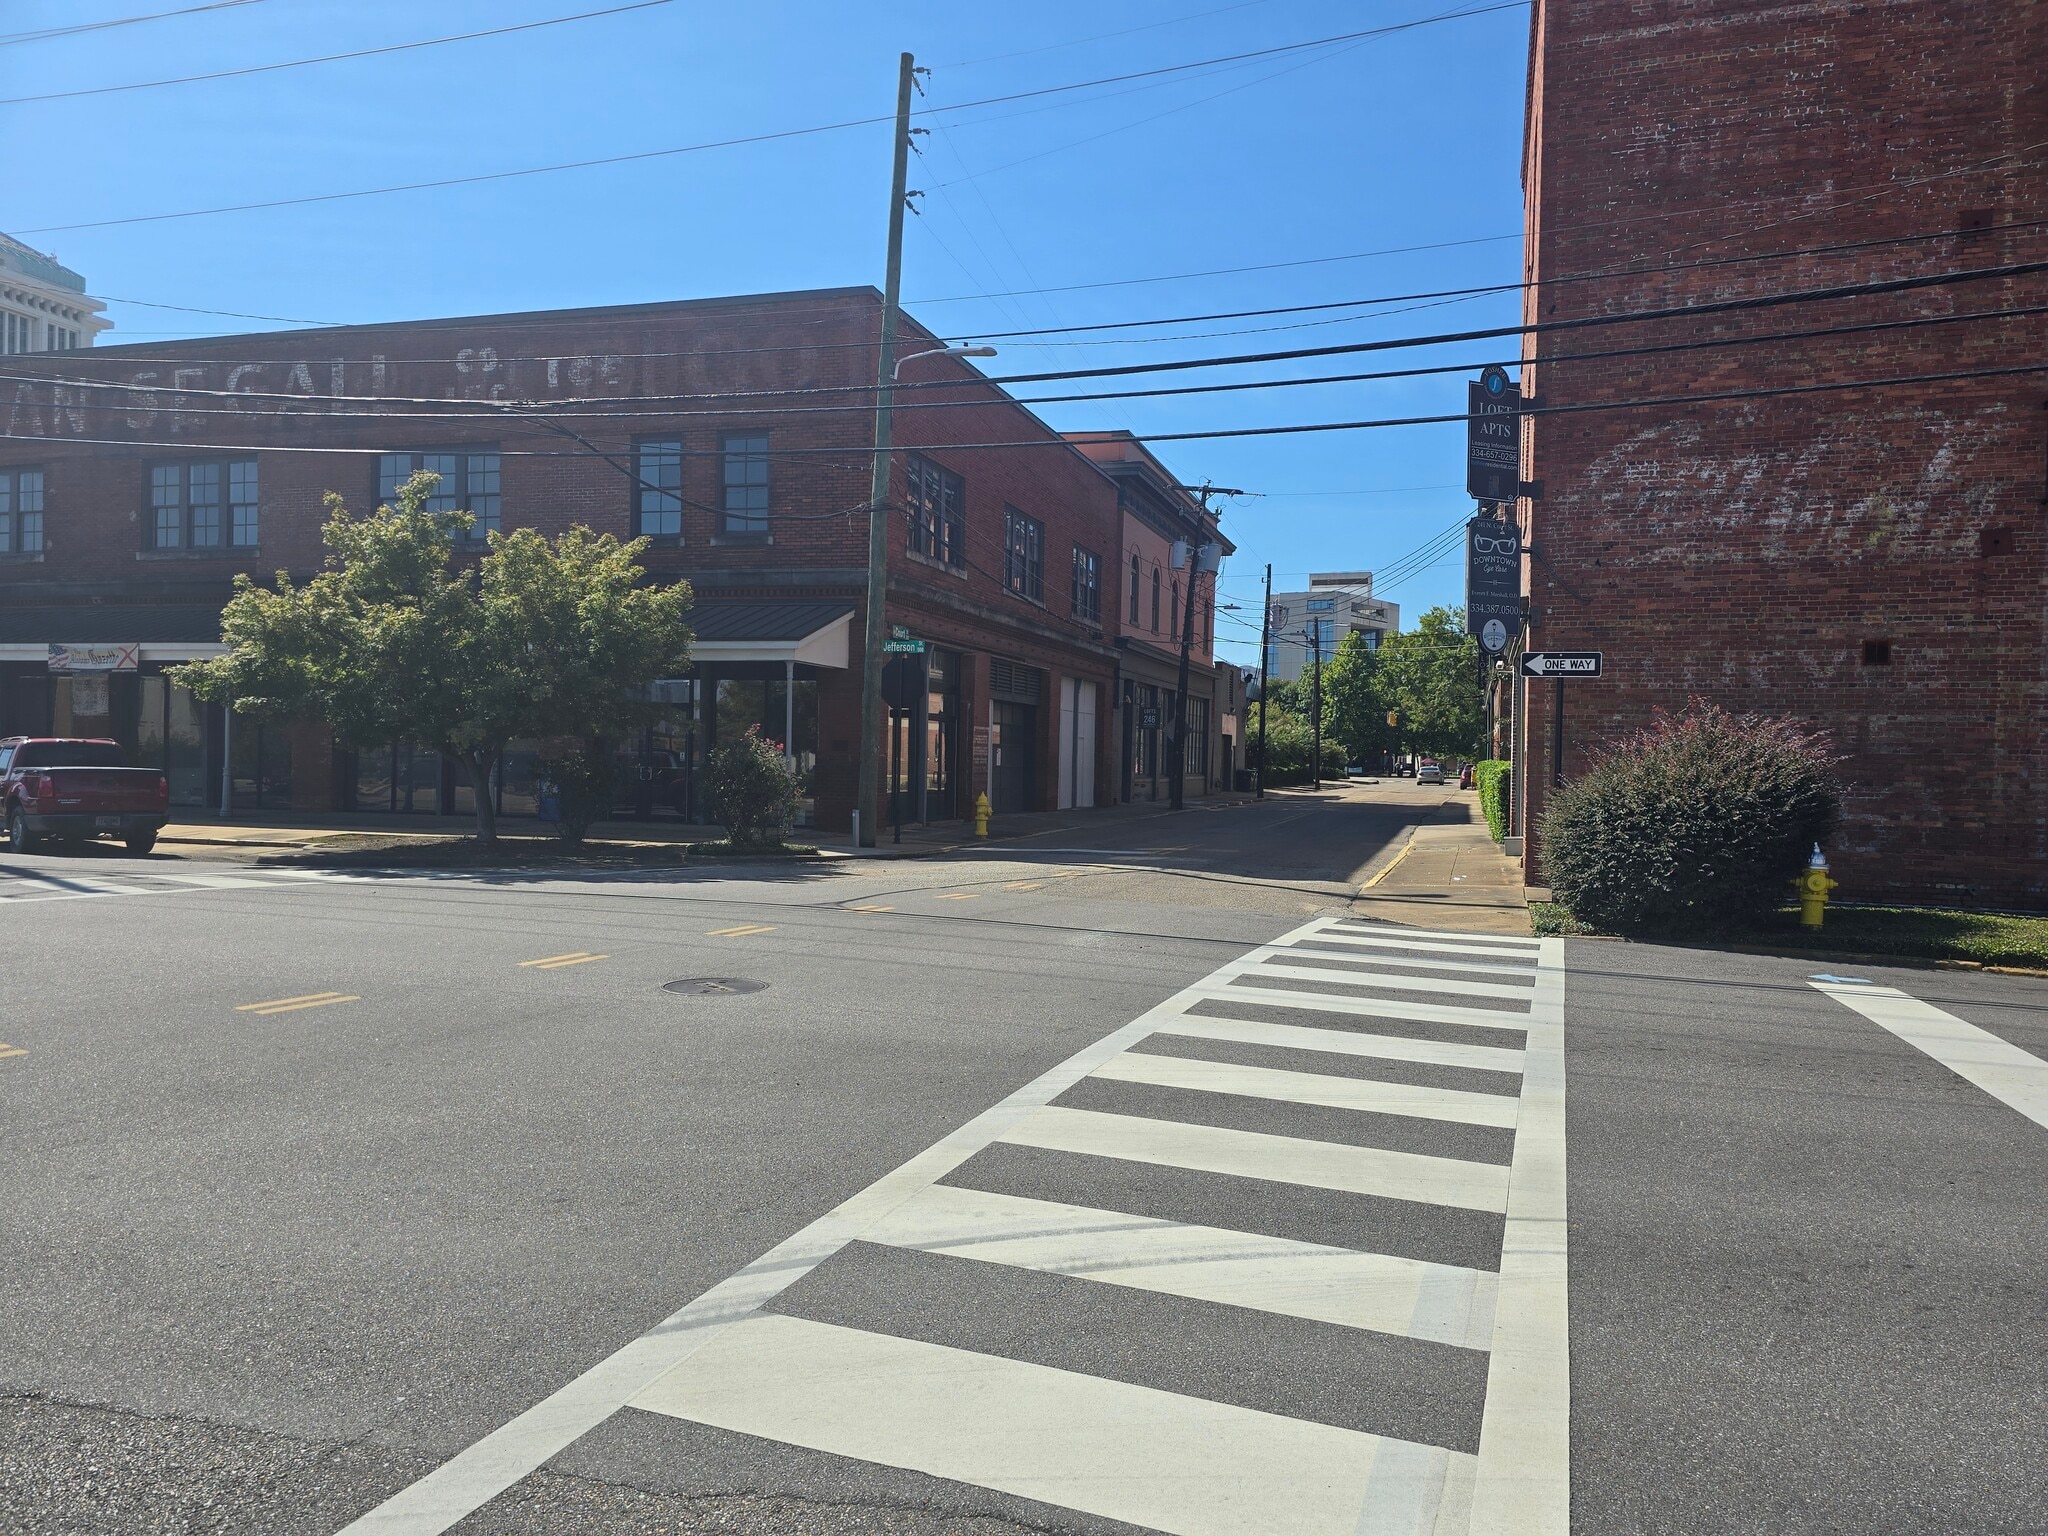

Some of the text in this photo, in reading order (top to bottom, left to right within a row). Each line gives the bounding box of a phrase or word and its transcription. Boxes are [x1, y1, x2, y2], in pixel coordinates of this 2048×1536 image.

[1480, 403, 1512, 418] LOFT
[1480, 422, 1511, 437] APTS
[1472, 440, 1490, 448] Leasing
[1472, 449, 1517, 461] 334-657-0296
[1474, 556, 1517, 567] DOWNTOWN
[1483, 563, 1508, 574] Eye Care
[1471, 603, 1518, 614] 334.387.0500
[883, 642, 915, 651] Jefferson
[1544, 659, 1593, 670] ONE WAY
[1143, 715, 1156, 723] 246
